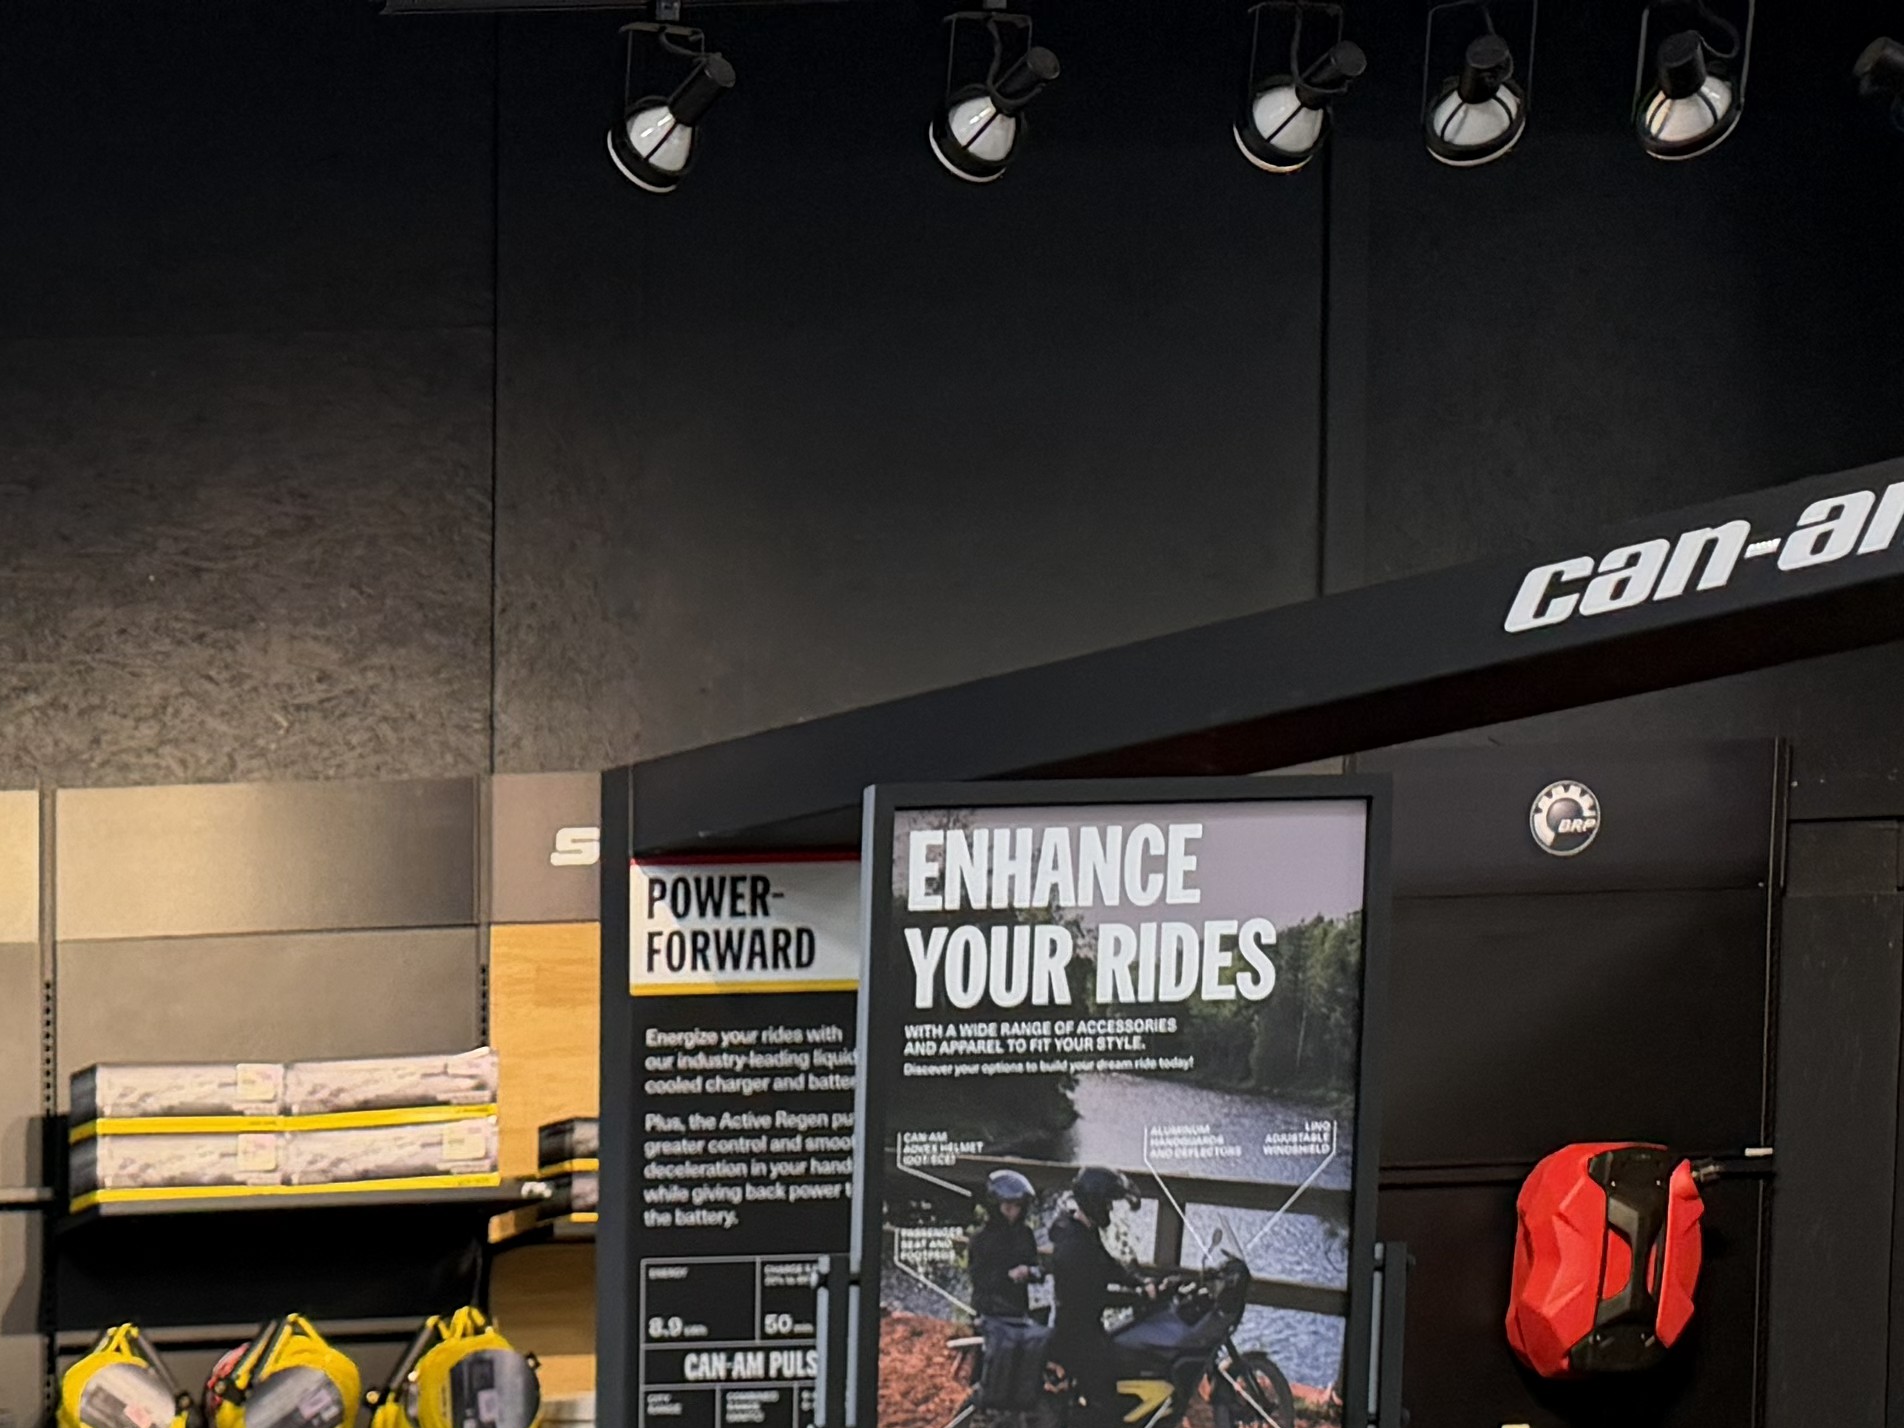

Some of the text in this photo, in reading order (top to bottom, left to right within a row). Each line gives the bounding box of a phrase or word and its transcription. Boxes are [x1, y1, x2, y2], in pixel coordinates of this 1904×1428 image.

[907, 823, 1203, 912] ENHANCE
[647, 875, 784, 919] POWER-
[647, 928, 816, 973] FORWARD
[904, 918, 1277, 1009] YOUR RIDES
[645, 1024, 842, 1049] Energize your rides with
[904, 1017, 1177, 1039] WITH A WIDE RANGE OF ACCESSORIES
[904, 1035, 1146, 1056] AND APPAREL TO FIT YOUR STYLE.
[645, 1055, 674, 1070] our
[954, 1063, 980, 1078] your
[1069, 1061, 1094, 1075] your
[1096, 1059, 1132, 1071] dream
[645, 1073, 856, 1096] cooled charger and batter
[645, 1110, 855, 1132] Plus, the Active Regen pu
[644, 1138, 705, 1159] greater
[707, 1135, 768, 1154] control
[770, 1134, 802, 1152] and
[644, 1160, 748, 1179] deceleration
[750, 1158, 767, 1176] in
[769, 1160, 807, 1180] your
[643, 1185, 689, 1203] while
[692, 1183, 742, 1205] giving
[745, 1183, 786, 1200] back
[789, 1184, 842, 1203] power
[643, 1208, 739, 1229] the battery.
[648, 1316, 683, 1338] 8.9
[764, 1314, 792, 1335] 50
[684, 1350, 818, 1381] CAN-AM PULS
